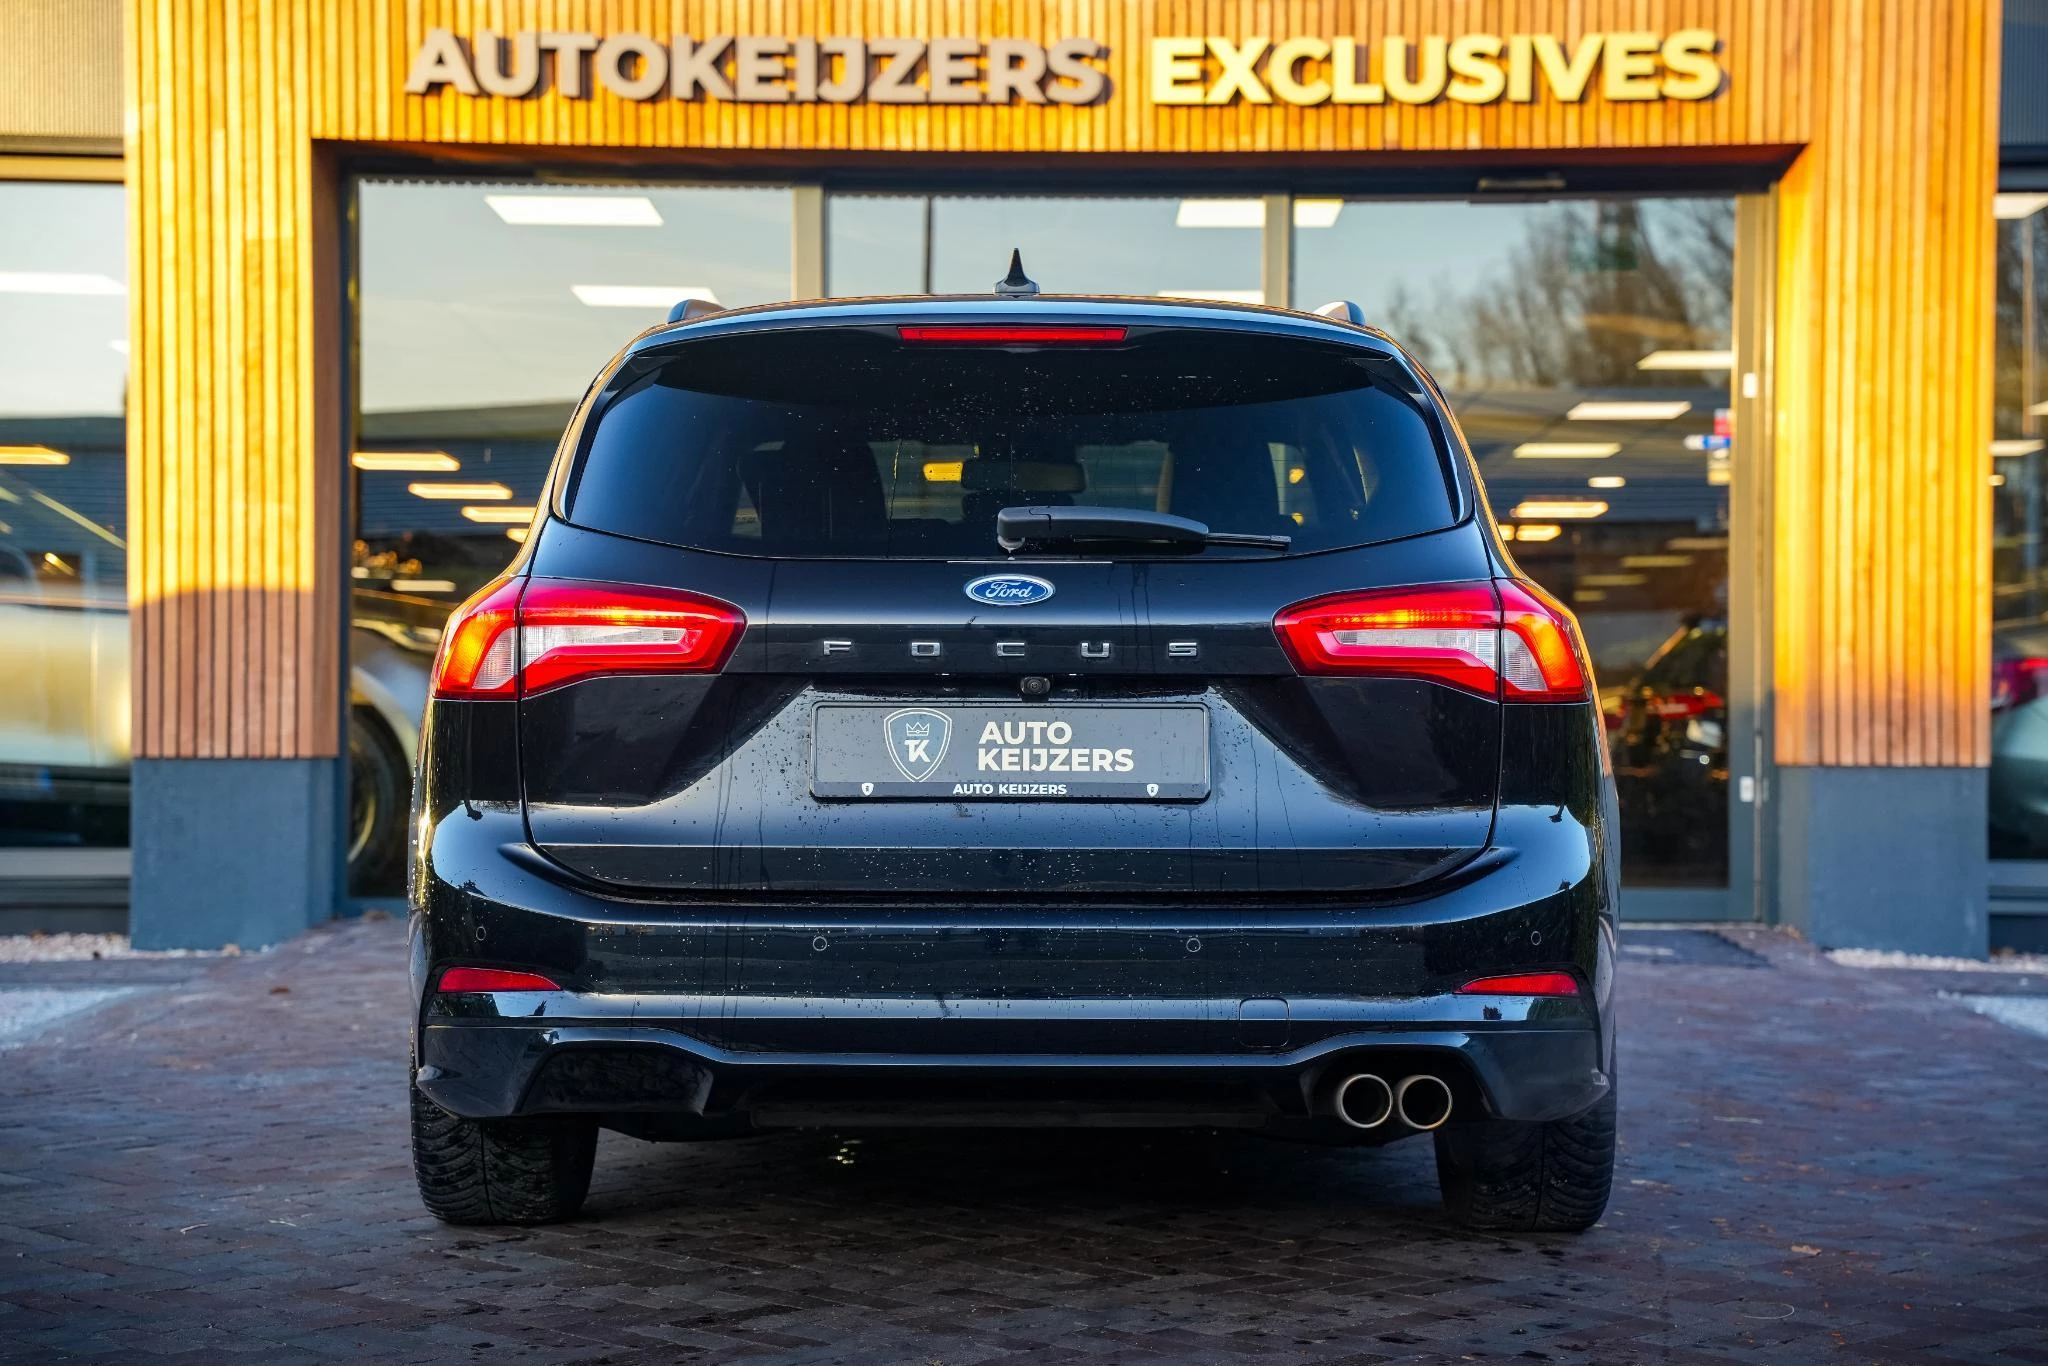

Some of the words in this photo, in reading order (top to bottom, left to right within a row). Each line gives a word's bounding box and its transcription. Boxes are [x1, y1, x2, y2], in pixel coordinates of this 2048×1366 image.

[405, 28, 1108, 104] AUTOKEIJZERS
[1151, 29, 1723, 106] EXCLUSIVES
[985, 581, 1033, 599] Ford
[823, 640, 1198, 658] FOCUS
[979, 721, 1072, 745] AUTO
[978, 748, 1134, 772] KEIJZERS
[952, 784, 994, 795] AUTO
[998, 784, 1067, 796] KEIJZERS
